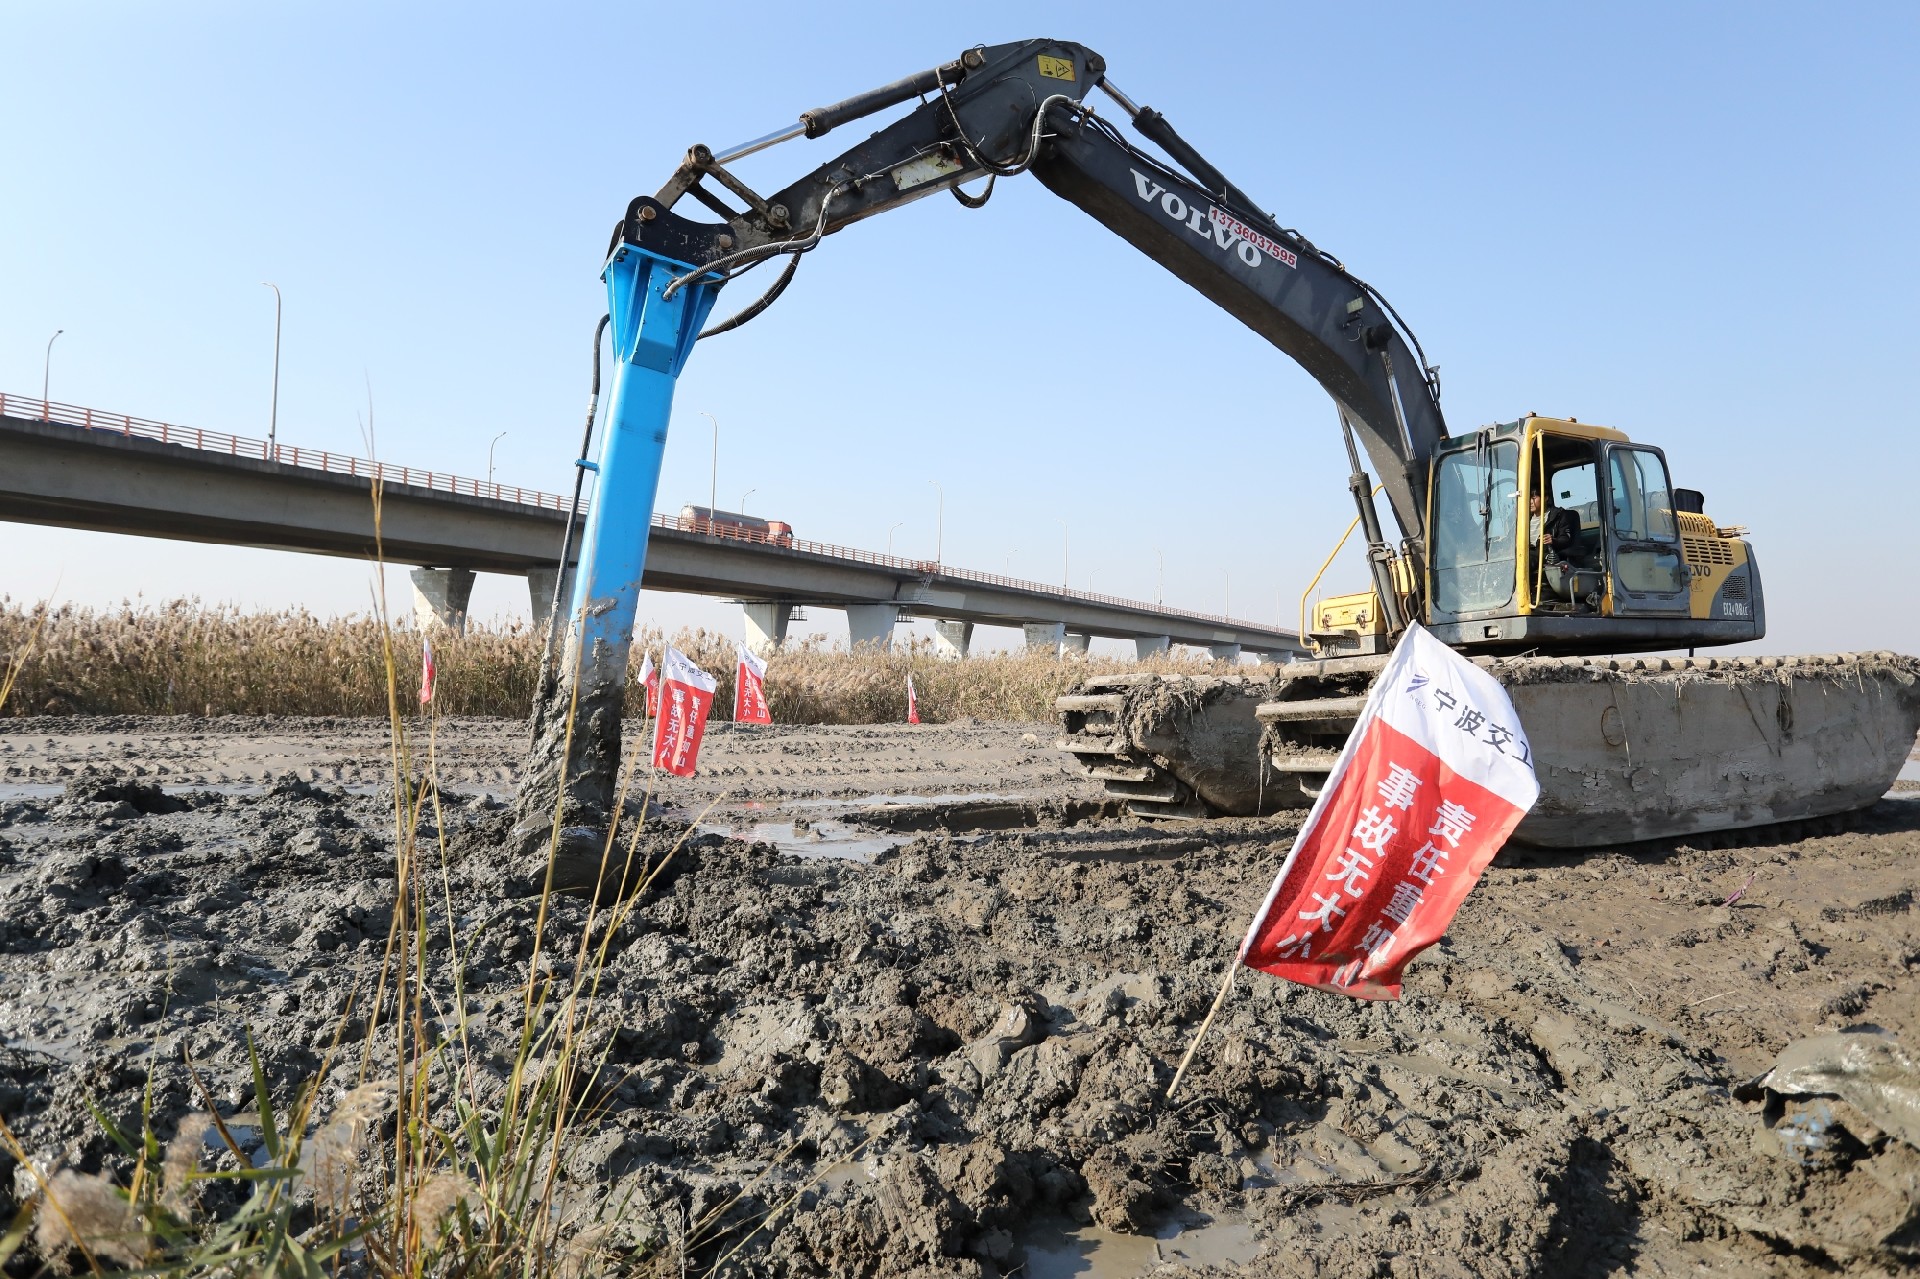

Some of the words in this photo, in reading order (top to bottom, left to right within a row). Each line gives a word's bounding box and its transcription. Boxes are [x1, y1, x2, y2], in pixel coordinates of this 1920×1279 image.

[1130, 168, 1262, 267] VOLVO
[1211, 208, 1296, 266] 13736037595
[1689, 564, 1711, 577] LVO
[1433, 687, 1534, 771] 宁波交工
[1276, 760, 1423, 960] 事故无大小
